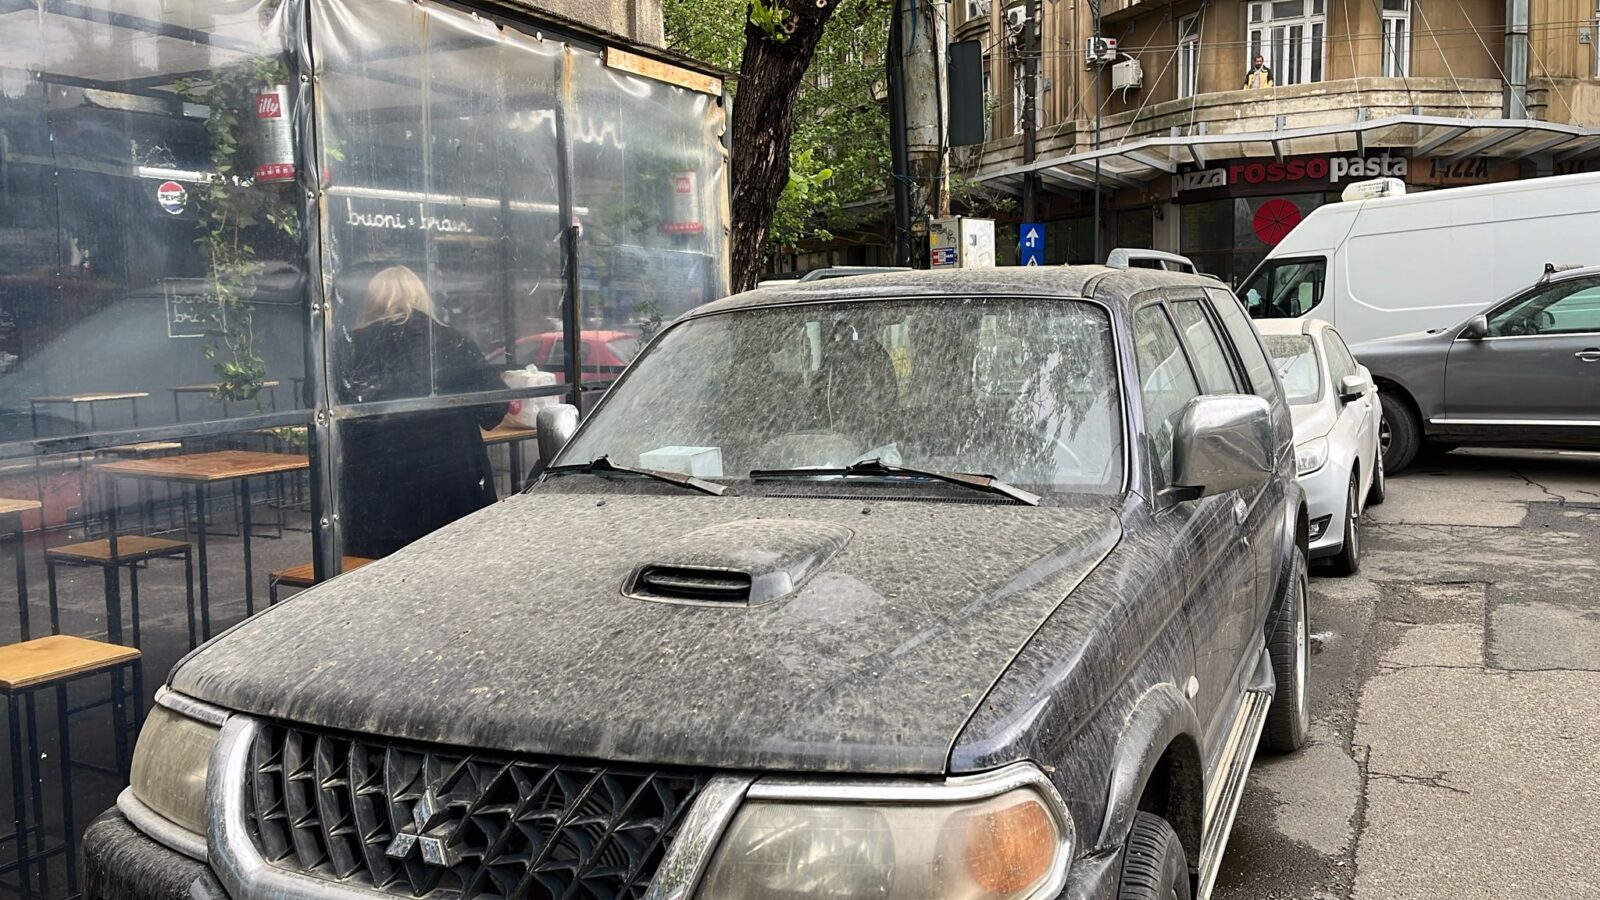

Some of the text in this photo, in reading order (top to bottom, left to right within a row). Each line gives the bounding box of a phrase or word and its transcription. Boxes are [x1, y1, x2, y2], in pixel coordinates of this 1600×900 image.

[259, 98, 279, 116] illy
[1171, 152, 1408, 197] pizza rosso pasta
[346, 197, 406, 228] buoni
